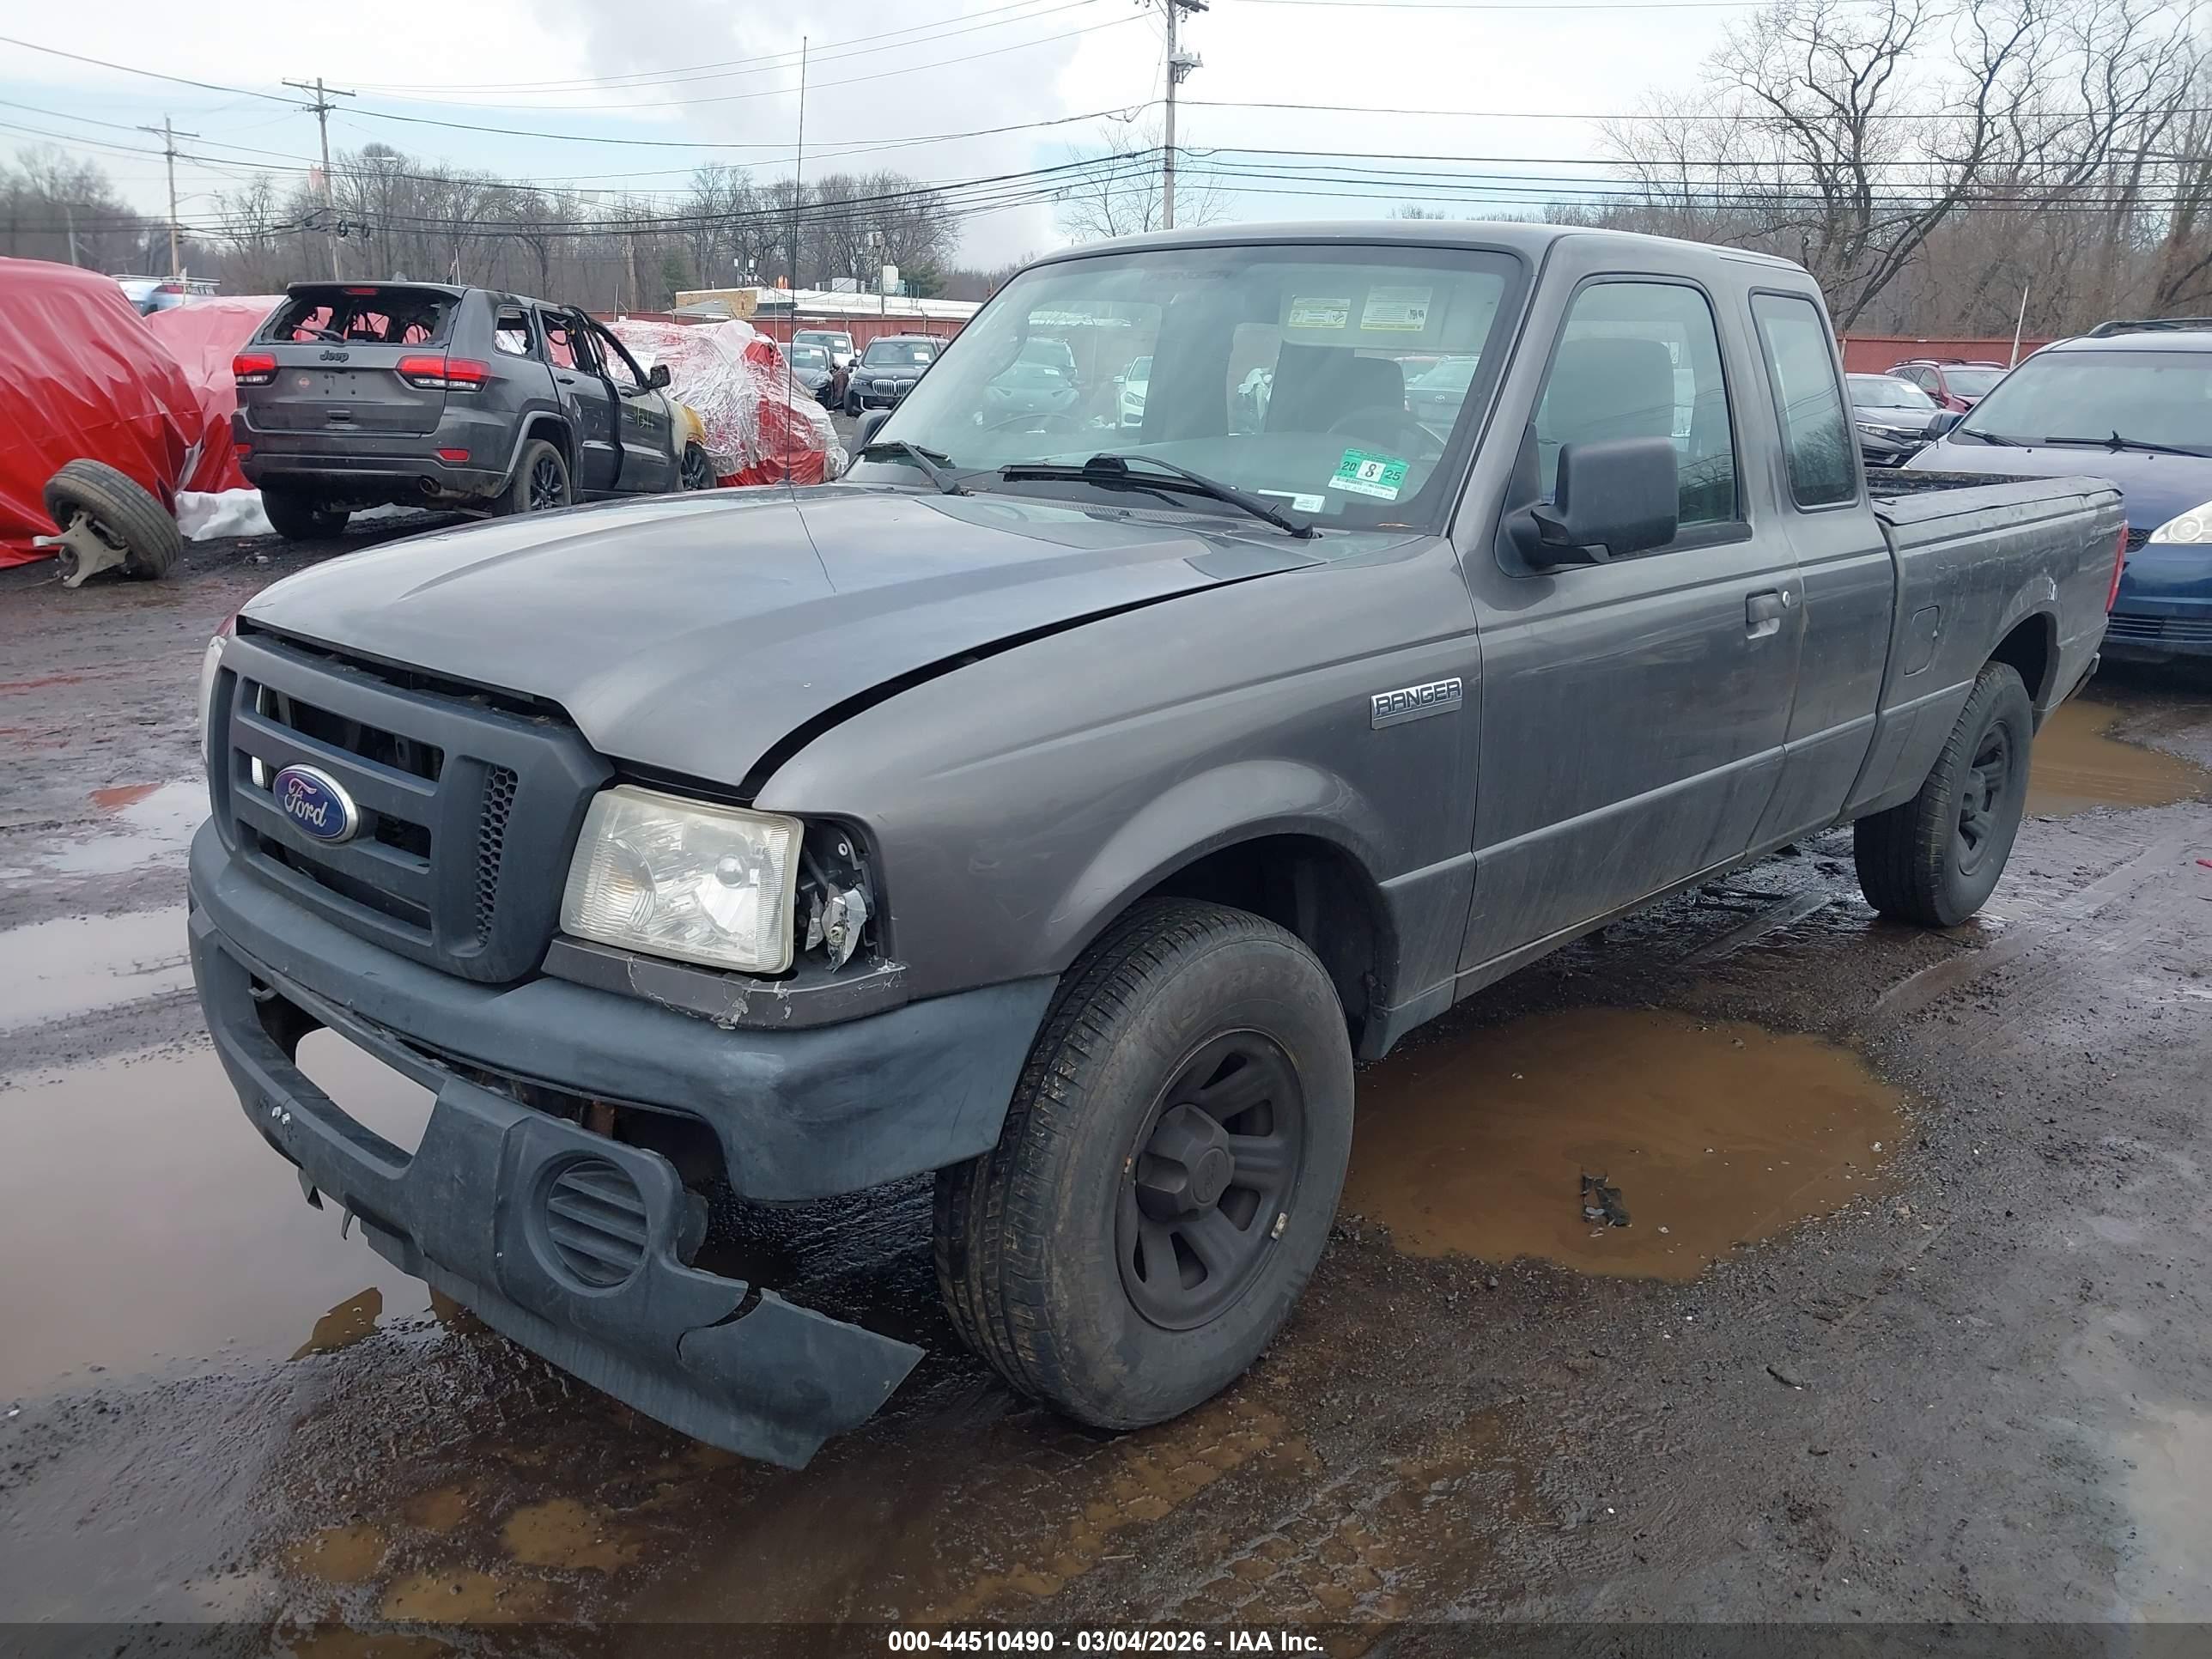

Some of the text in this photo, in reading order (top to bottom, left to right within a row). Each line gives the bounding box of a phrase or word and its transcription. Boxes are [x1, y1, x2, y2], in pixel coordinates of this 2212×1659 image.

[319, 349, 349, 363] Jeep
[1341, 461, 1401, 481] 20 8 25
[1375, 680, 1462, 715] RANGER
[284, 777, 328, 828] Ford
